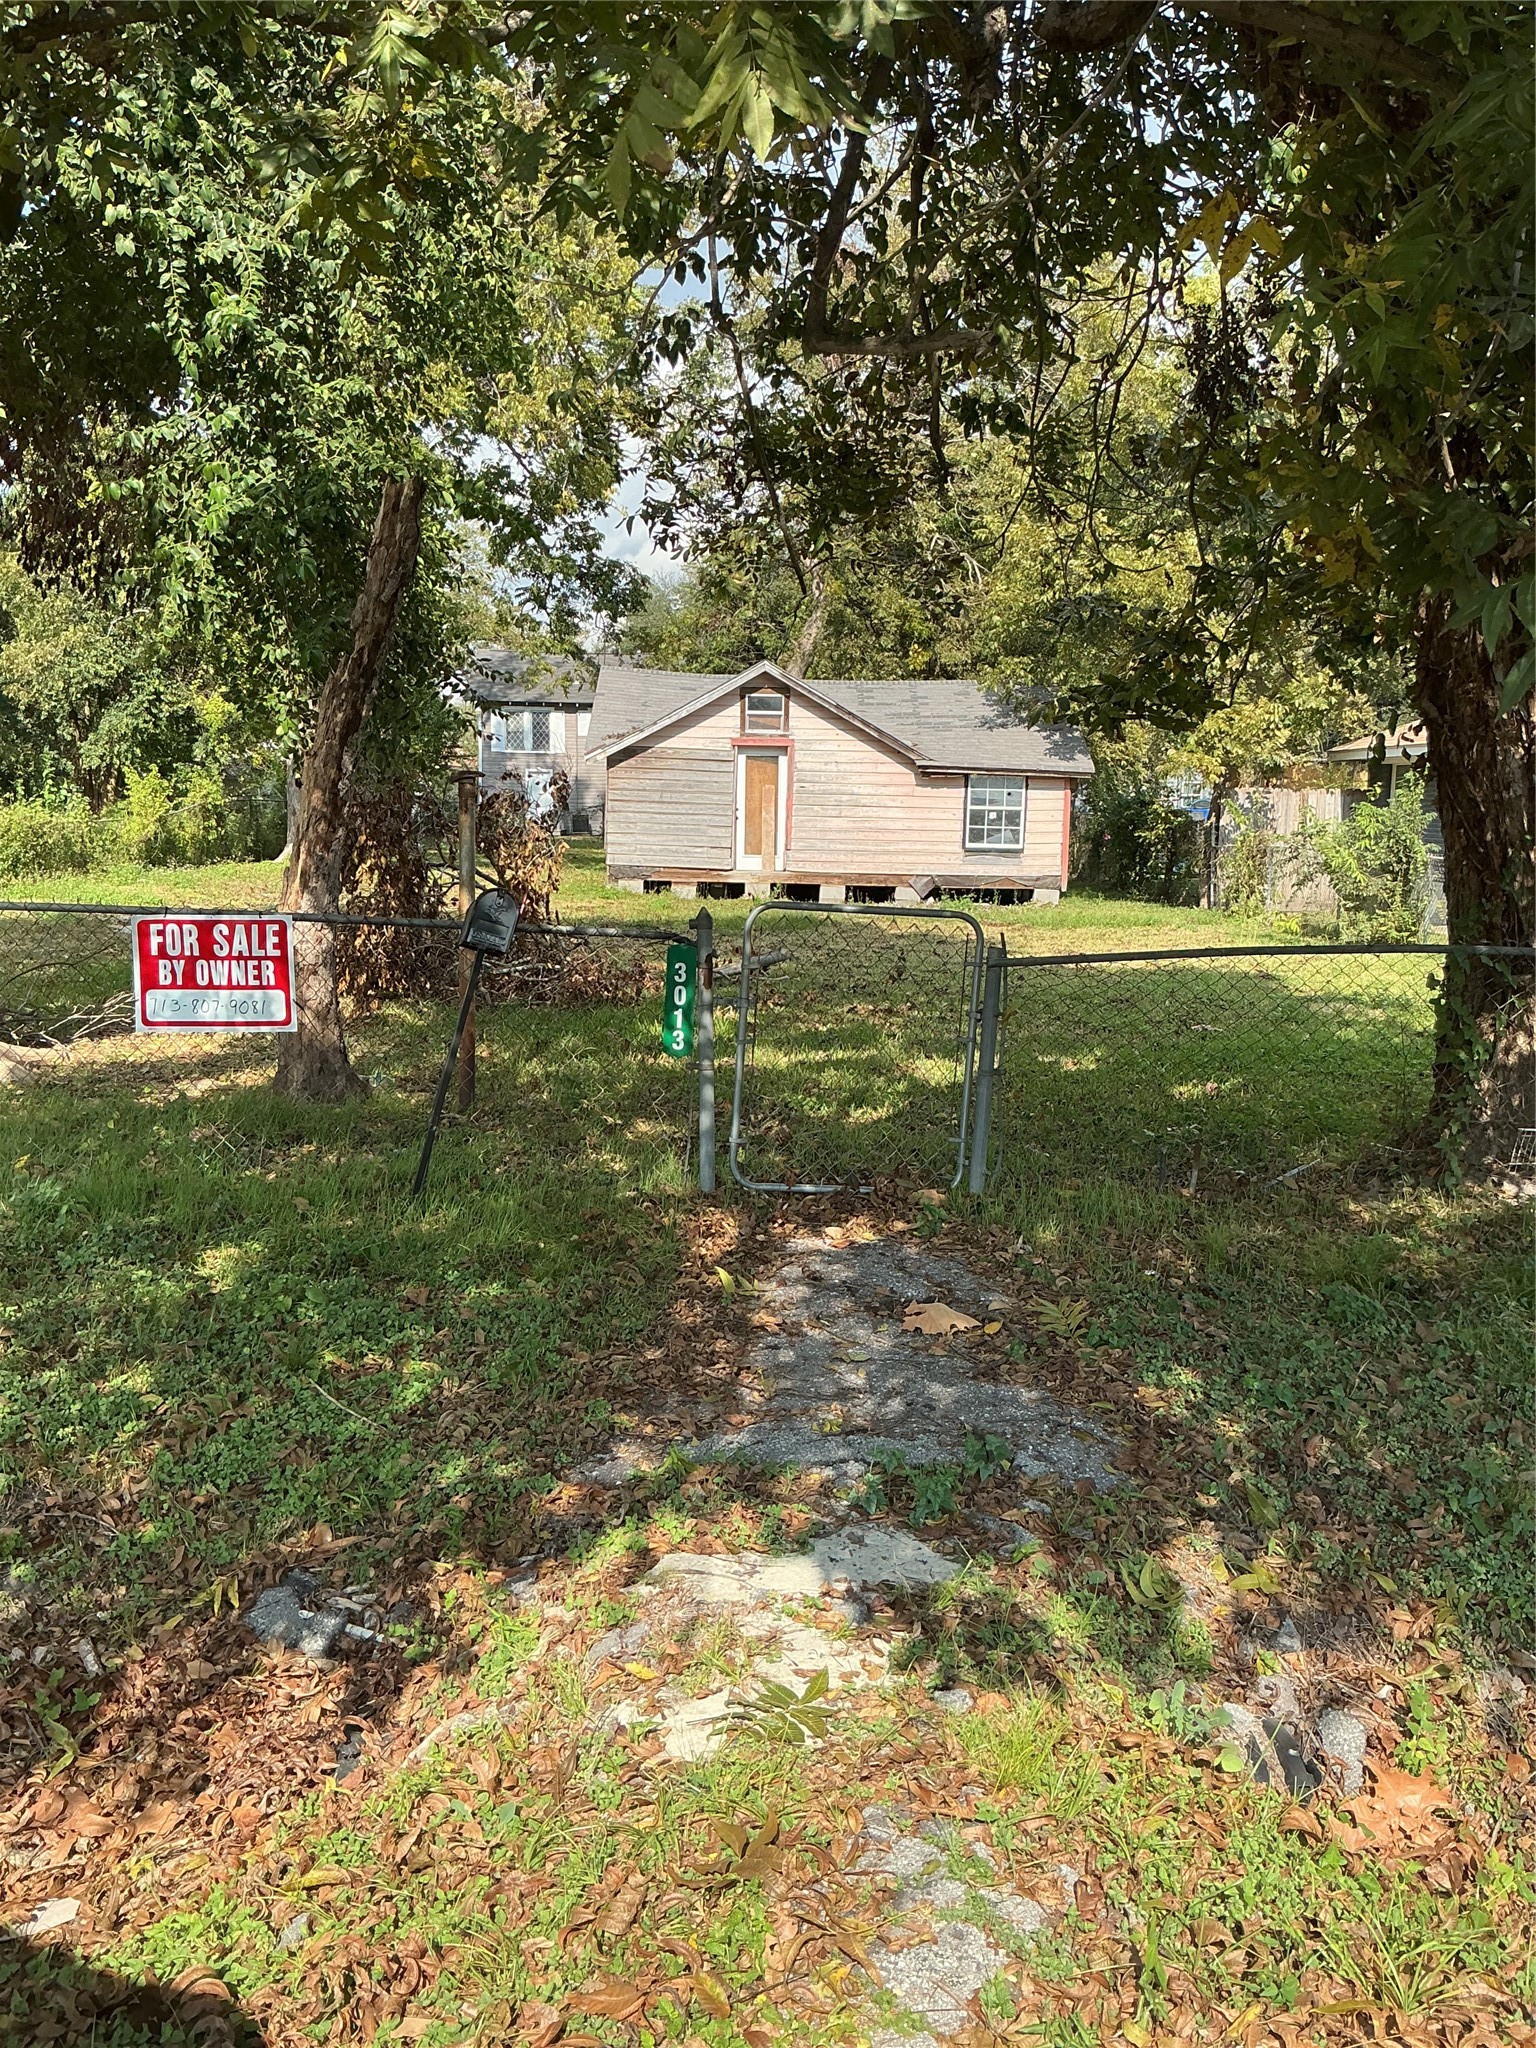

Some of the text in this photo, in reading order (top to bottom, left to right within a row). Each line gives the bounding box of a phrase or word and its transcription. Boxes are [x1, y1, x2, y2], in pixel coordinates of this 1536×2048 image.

[150, 923, 281, 957] FOR SALE
[159, 959, 275, 986] BY OWNER
[150, 997, 266, 1015] 713-807-9081
[671, 962, 687, 1051] 3013
